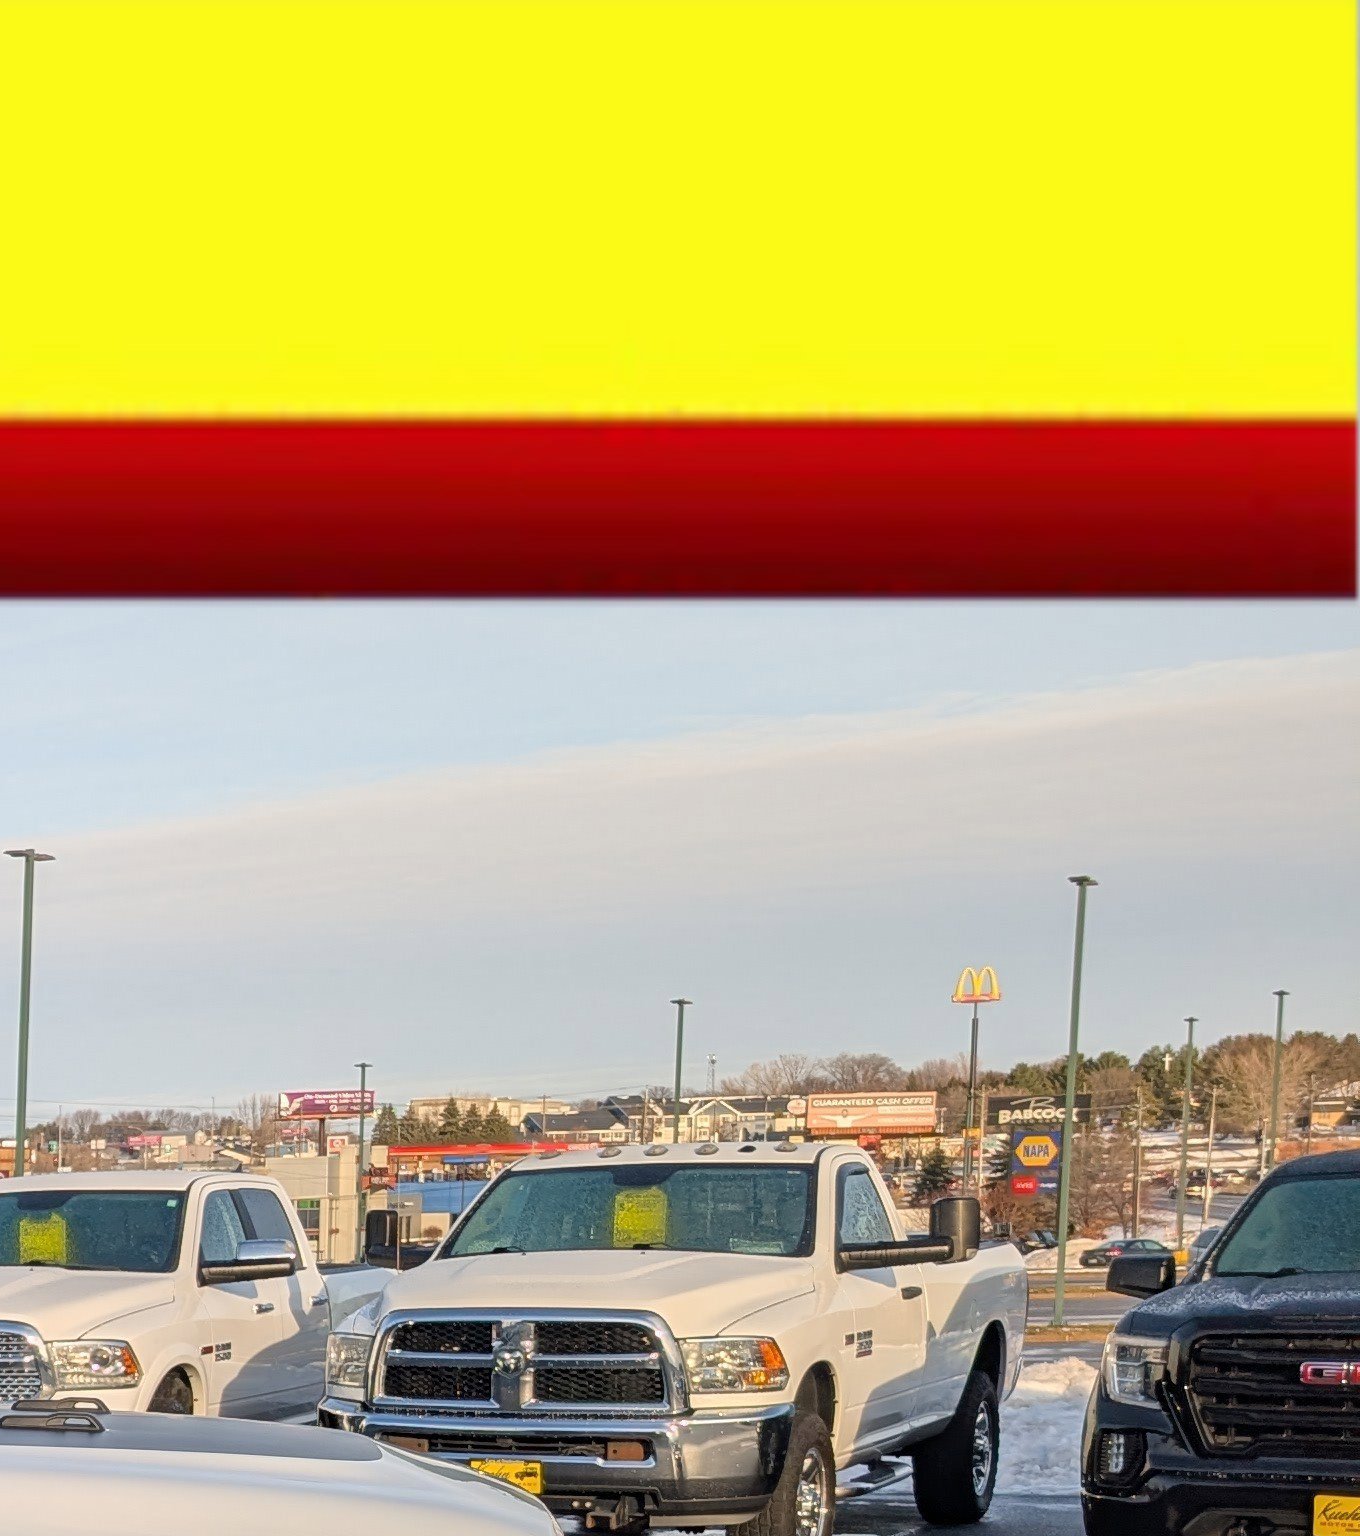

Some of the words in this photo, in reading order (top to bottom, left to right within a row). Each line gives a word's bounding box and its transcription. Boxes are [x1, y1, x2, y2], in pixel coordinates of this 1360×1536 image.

[812, 1098, 874, 1107] GUARANTEED
[876, 1097, 901, 1106] CASH
[902, 1097, 932, 1105] OFFER
[1022, 1144, 1050, 1158] NAPA
